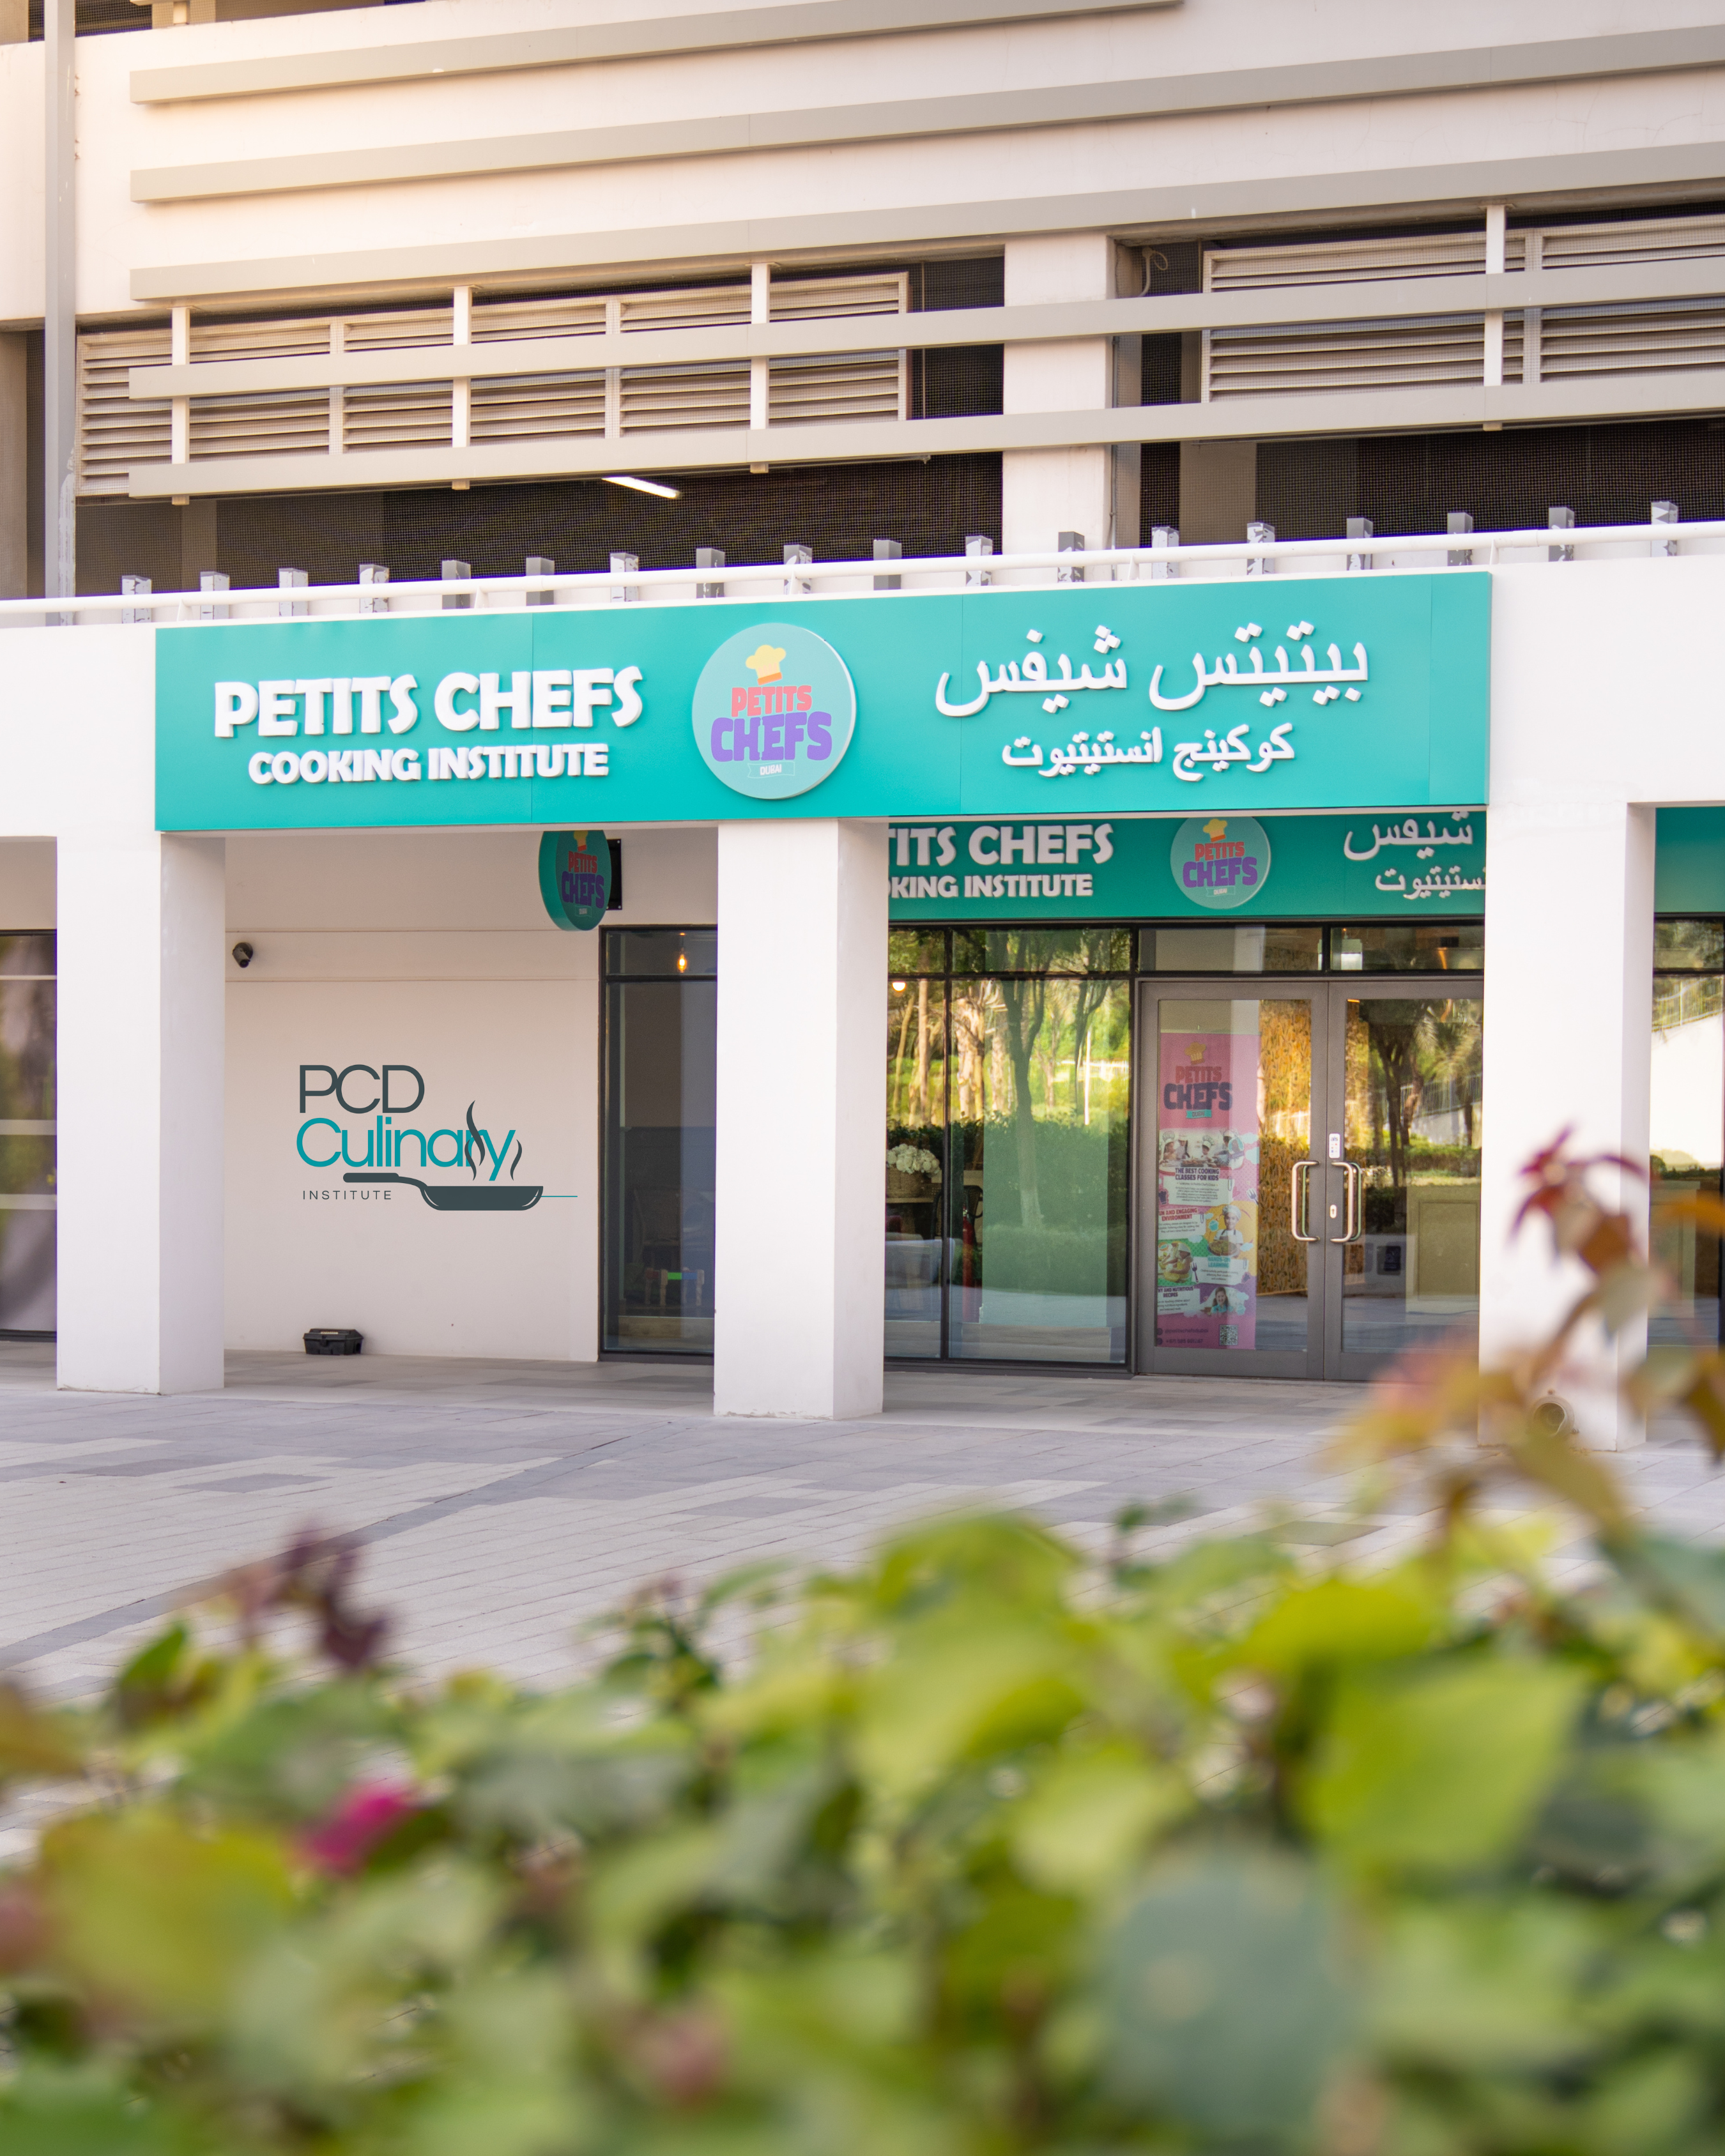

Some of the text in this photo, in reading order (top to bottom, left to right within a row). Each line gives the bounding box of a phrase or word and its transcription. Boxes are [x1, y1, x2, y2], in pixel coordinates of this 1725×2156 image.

[935, 620, 1368, 717] بيتيتس شيفس
[214, 666, 643, 738] PETITS CHEFS
[732, 685, 812, 717] PETITS
[711, 711, 832, 762] CHEFS
[1002, 722, 1295, 782] كوكينج انستيتيوت
[248, 744, 609, 784] COOKING INSTITUTE
[760, 764, 782, 776] DUBAI
[888, 823, 1114, 866] ITS CHEFS
[1195, 841, 1245, 862] PETITS
[568, 851, 597, 874] PETITS
[1183, 857, 1258, 888] CHEFS
[562, 871, 604, 909] CHEFS
[888, 874, 1094, 898] KING INSTITUTE
[1375, 866, 1485, 899] ستيتيوت
[300, 1064, 425, 1113] PCD
[1176, 1066, 1222, 1083] PETITS
[1163, 1082, 1232, 1110] CHEFS
[296, 1115, 516, 1181] Culinary
[303, 1190, 392, 1200] INSTITUTE
